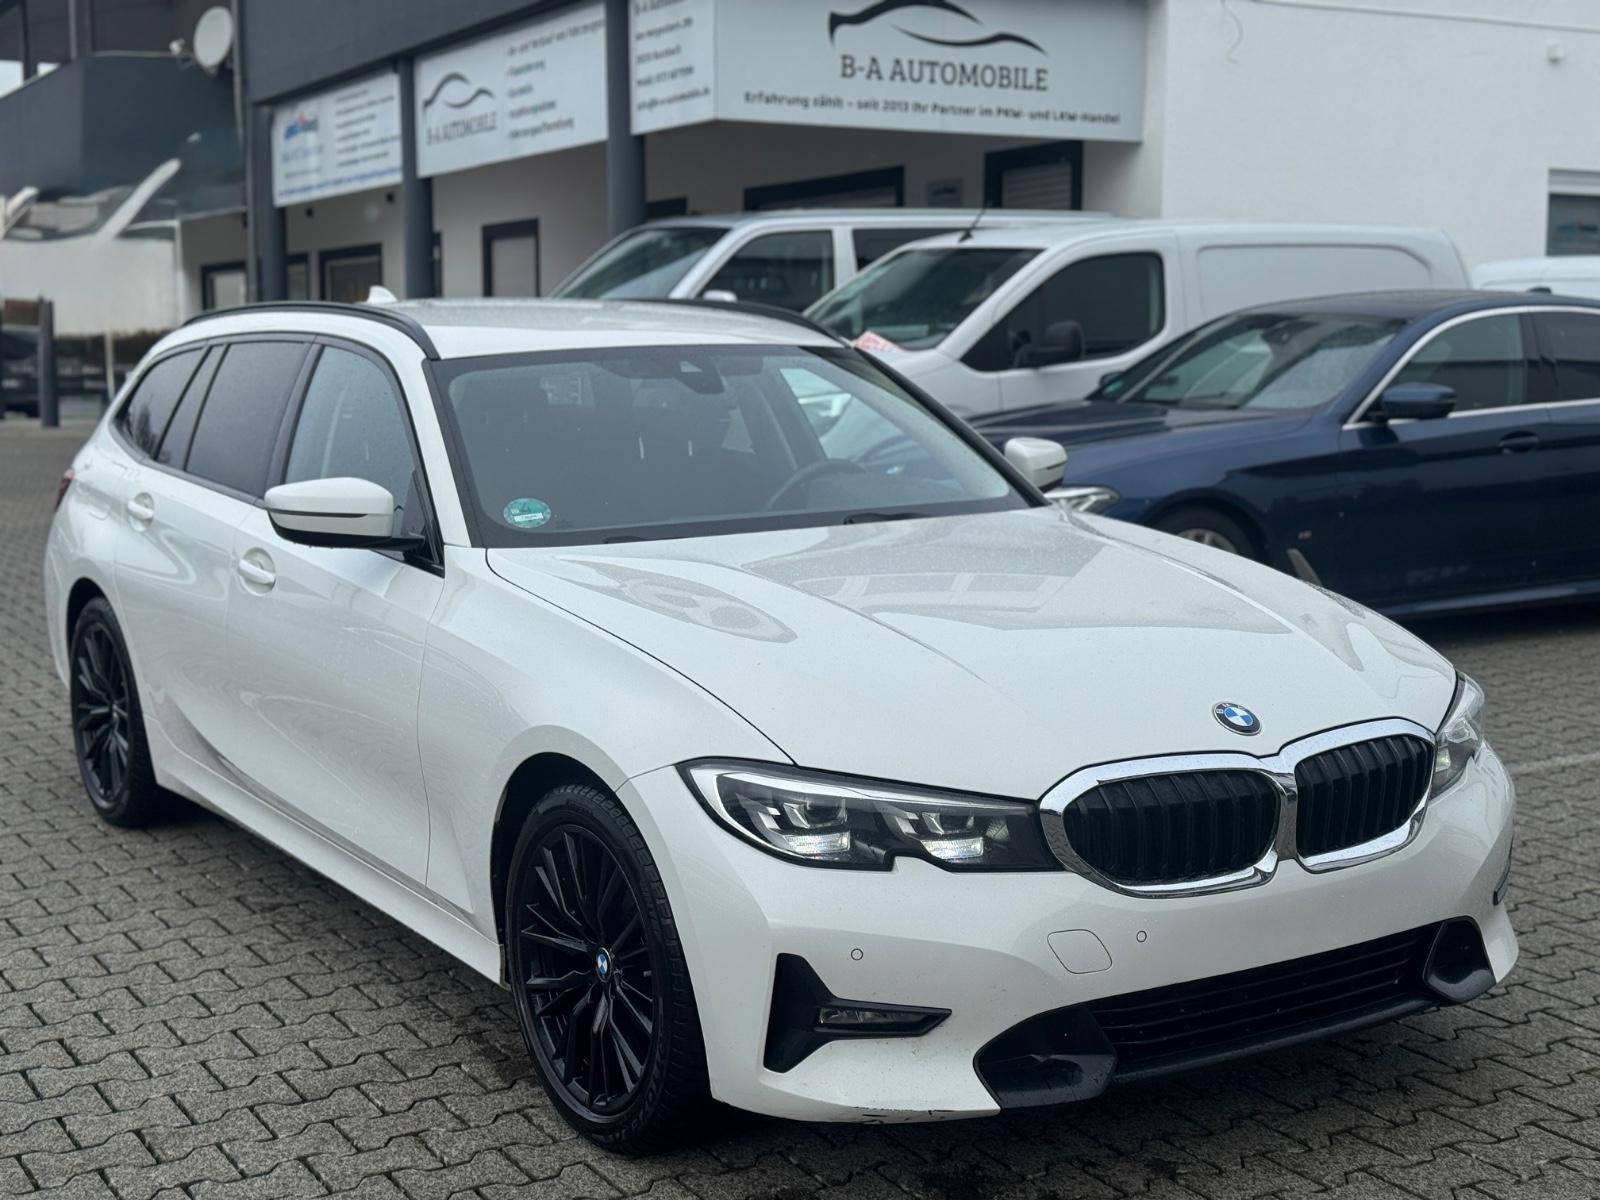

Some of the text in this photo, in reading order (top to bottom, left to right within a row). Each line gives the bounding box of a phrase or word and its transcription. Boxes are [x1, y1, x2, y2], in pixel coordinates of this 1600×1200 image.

[840, 54, 1049, 91] B-A AUTOMOBILE
[743, 91, 810, 111] Erfahrung
[812, 96, 844, 110] zählt
[857, 98, 880, 112] seit
[911, 101, 928, 114] Ihr
[931, 103, 976, 118] Partner
[979, 105, 993, 118] im
